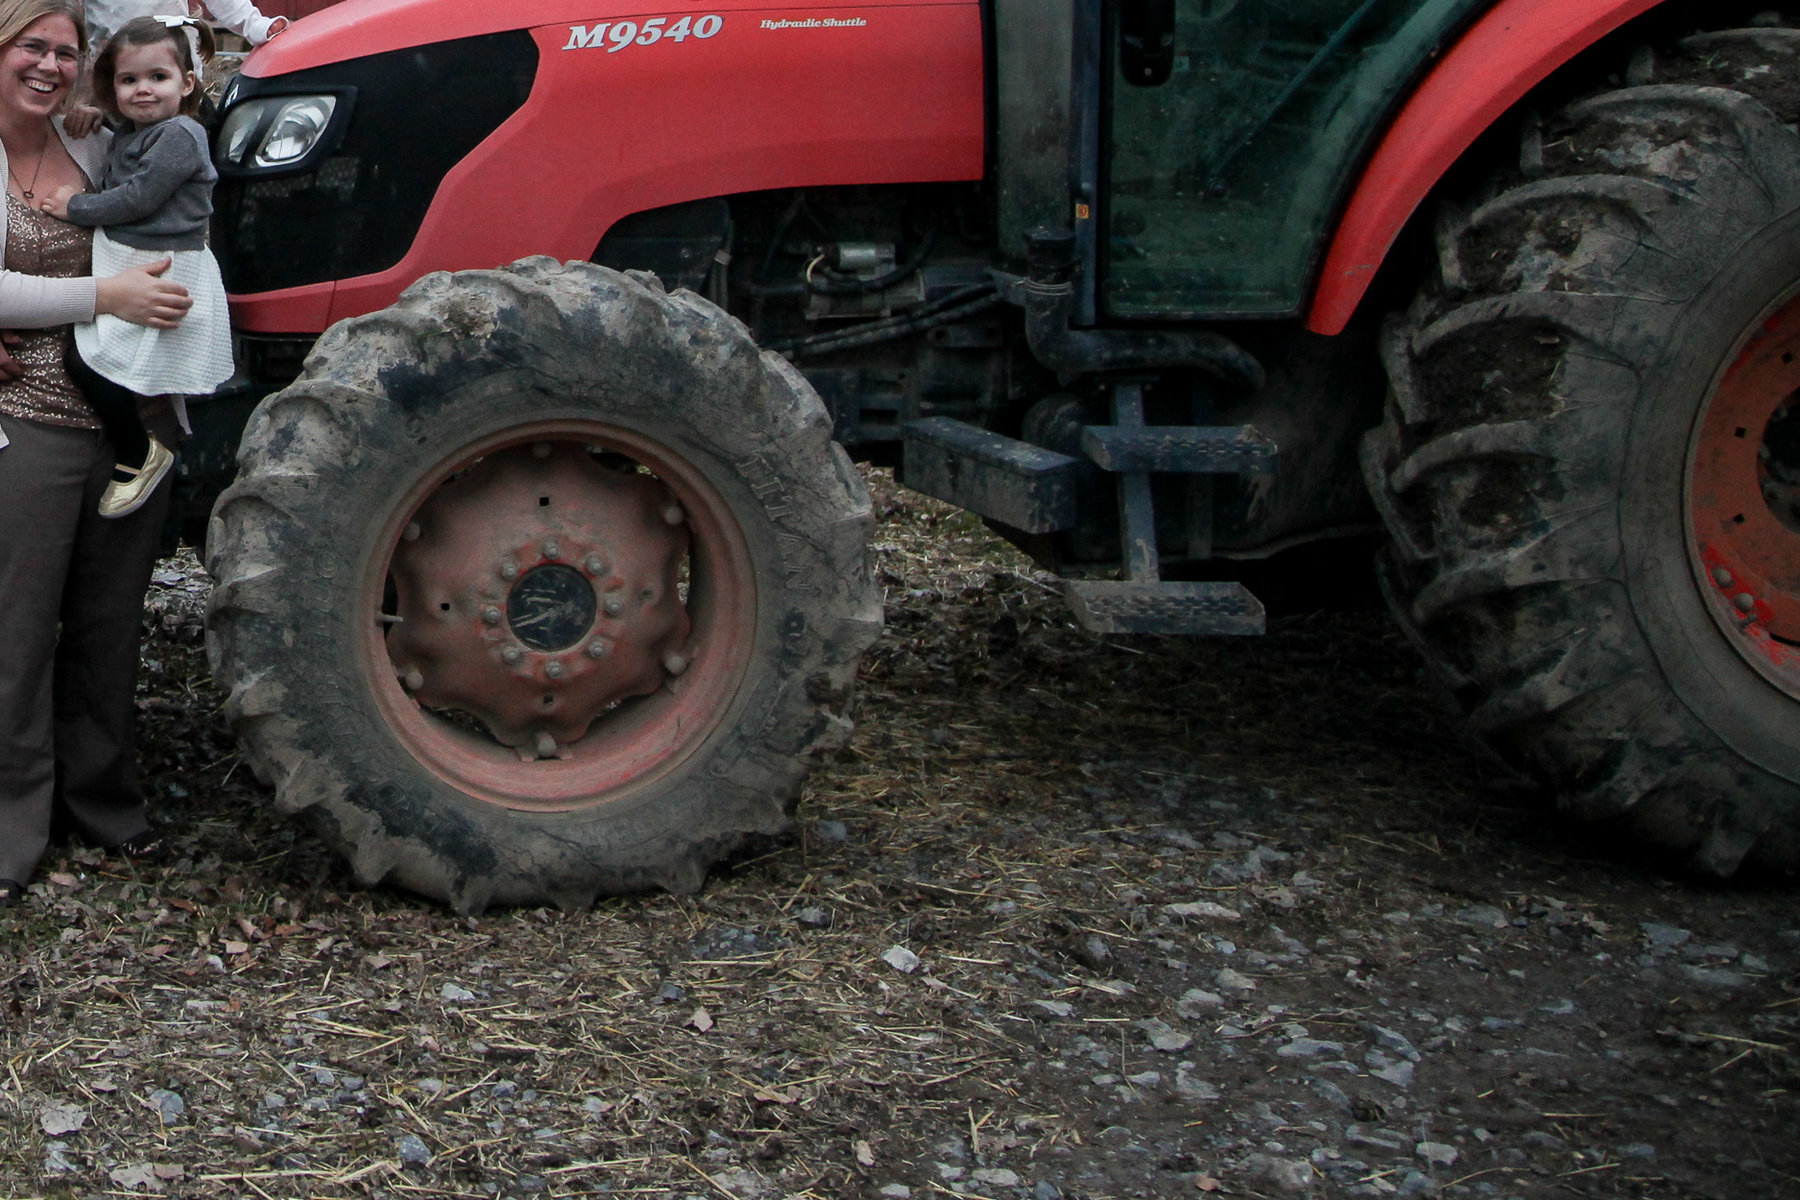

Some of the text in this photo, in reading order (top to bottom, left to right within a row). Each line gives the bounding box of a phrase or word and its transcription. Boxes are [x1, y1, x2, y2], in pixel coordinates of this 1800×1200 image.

[561, 14, 725, 53] M9540
[760, 17, 867, 30] Hydraulic Shuttle
[735, 448, 812, 590] TITAN
